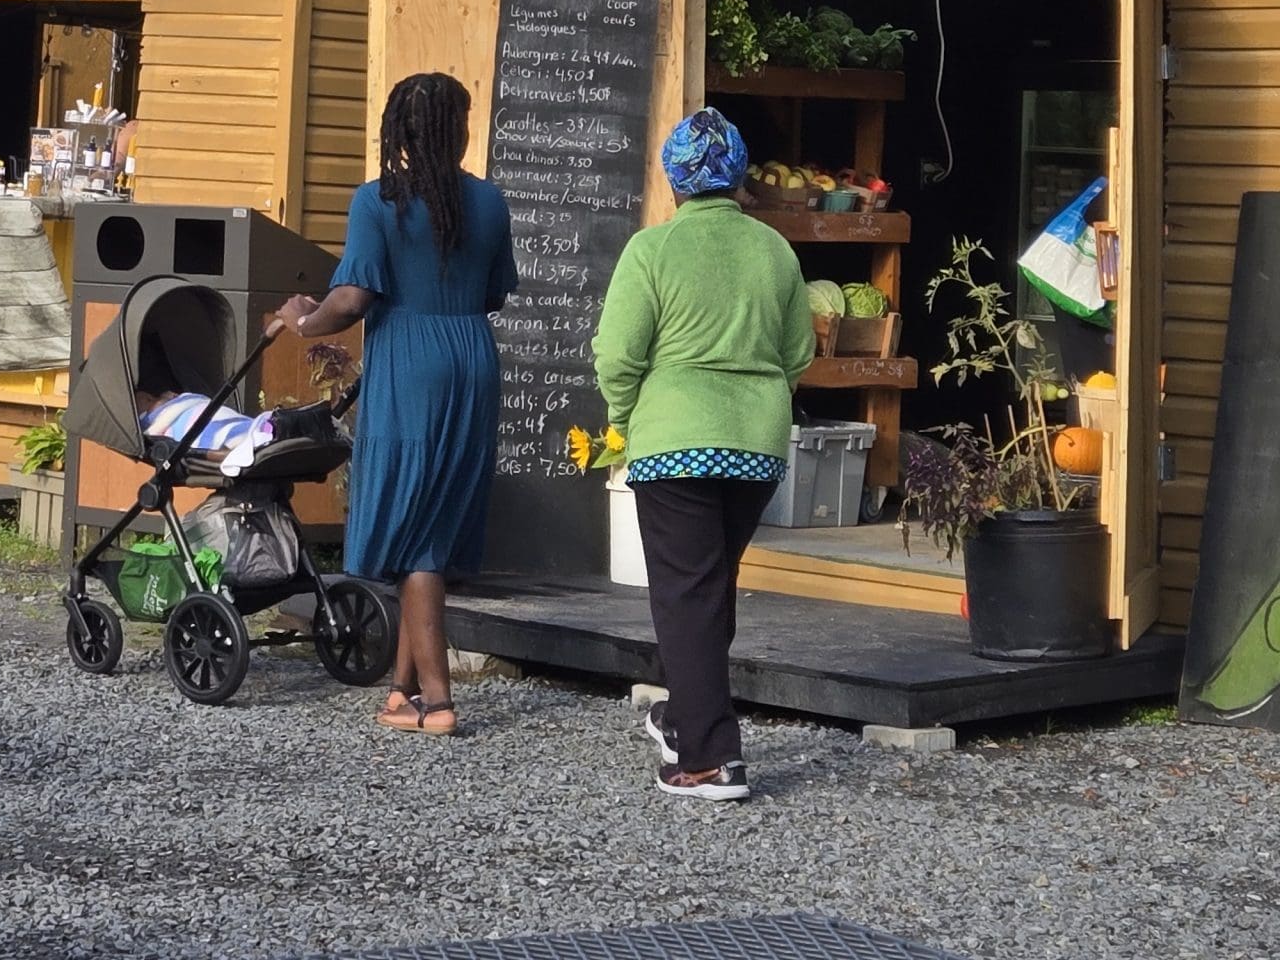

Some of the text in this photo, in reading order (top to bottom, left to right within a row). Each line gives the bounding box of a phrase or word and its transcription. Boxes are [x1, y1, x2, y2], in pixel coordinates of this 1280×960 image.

[607, 0, 638, 10] COOP
[577, 11, 587, 21] et
[603, 15, 636, 27] oeufs
[495, 107, 550, 133] Carottes
[495, 129, 527, 141] Chou
[492, 143, 522, 161] Chou
[545, 390, 570, 411] 6$
[525, 413, 547, 434] 4$
